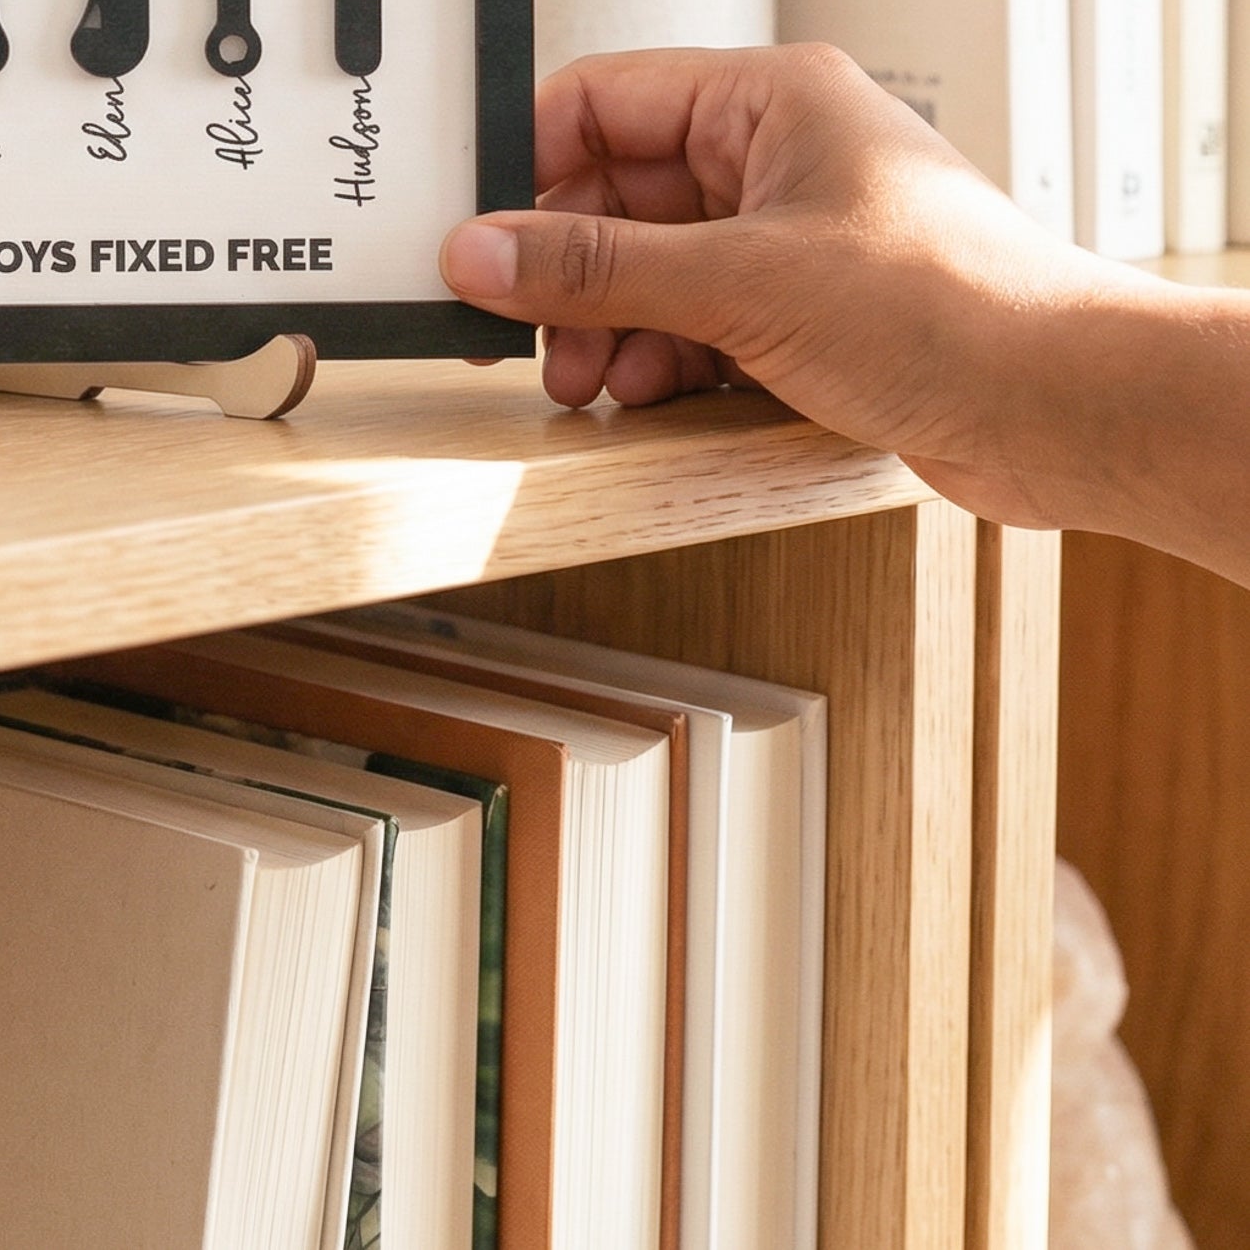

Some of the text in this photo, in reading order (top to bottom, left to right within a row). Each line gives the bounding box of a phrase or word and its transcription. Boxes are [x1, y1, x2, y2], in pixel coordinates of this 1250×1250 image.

[81, 77, 132, 162] Eden
[205, 76, 264, 170] Alice
[328, 76, 381, 207] Hudson
[90, 240, 215, 273] FIXED
[227, 238, 333, 272] FREE
